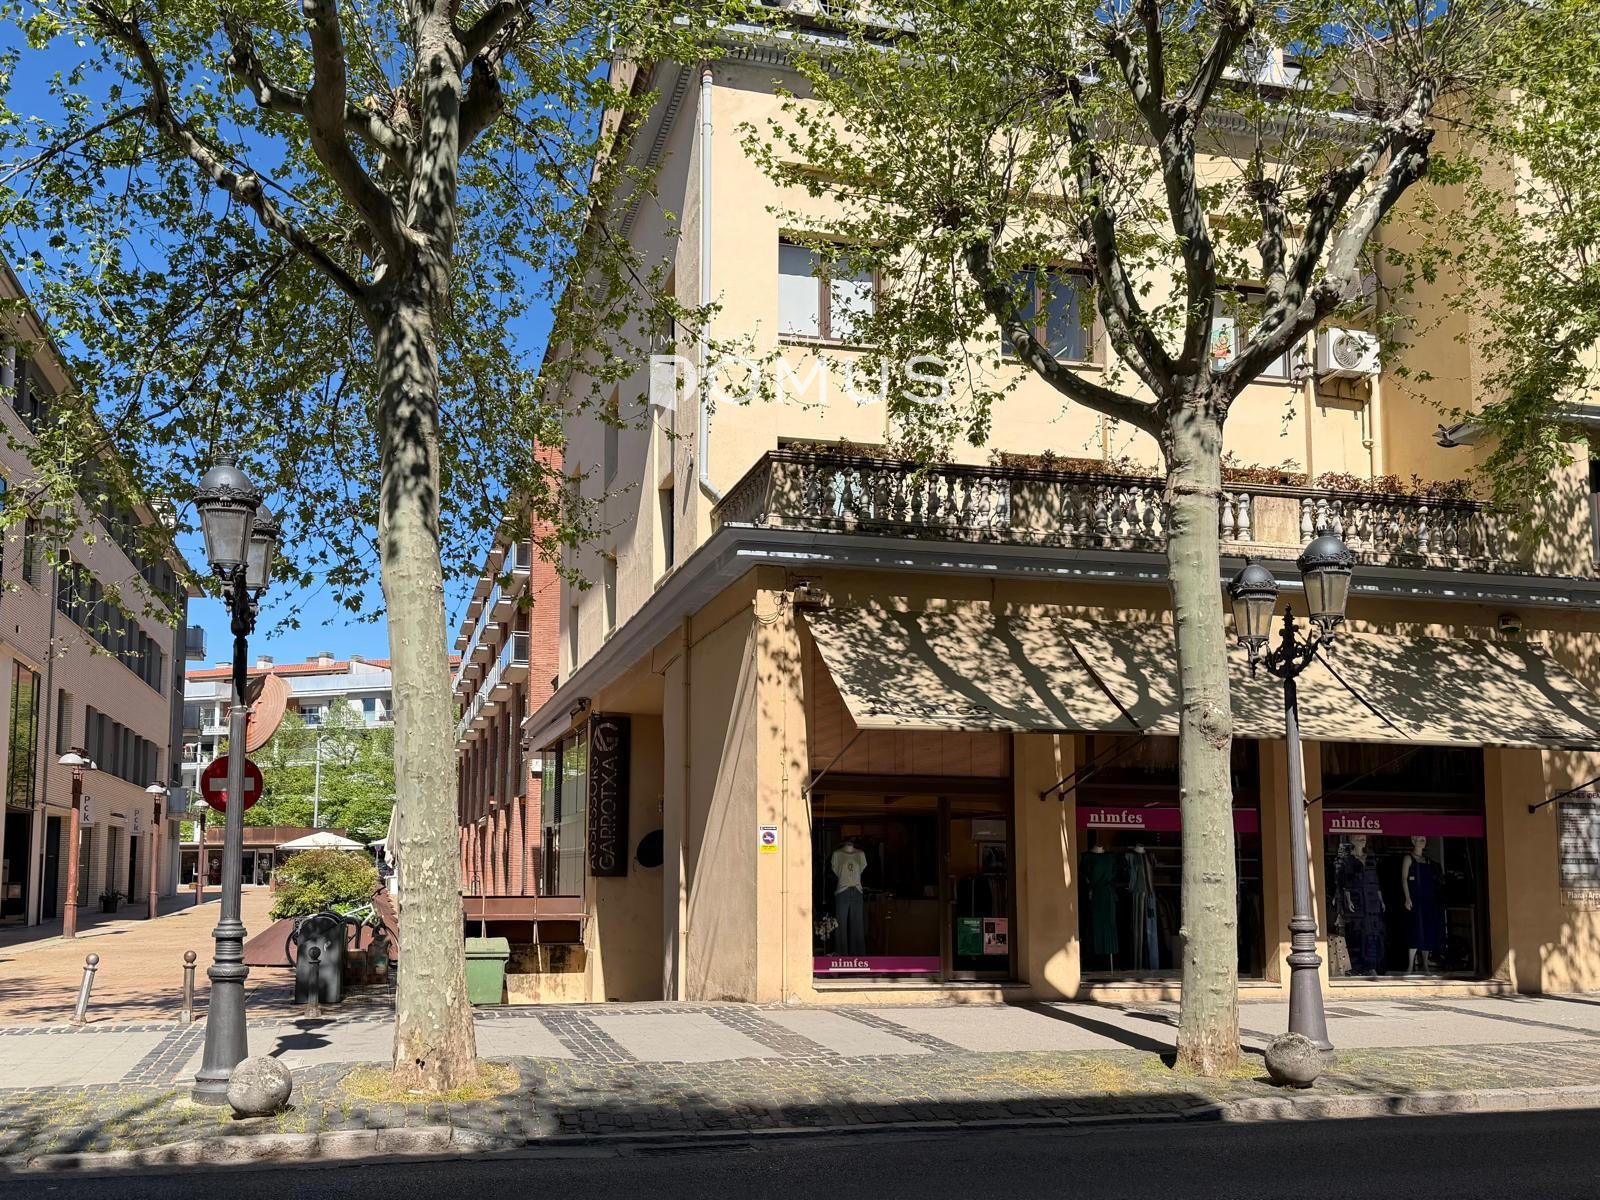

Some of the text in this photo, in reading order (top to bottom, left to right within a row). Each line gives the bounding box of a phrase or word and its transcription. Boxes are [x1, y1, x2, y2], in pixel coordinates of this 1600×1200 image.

[599, 755, 618, 870] GARROTXA
[1089, 809, 1143, 824] nimfes
[1331, 815, 1381, 829] nimfes
[831, 958, 869, 968] nimfes
